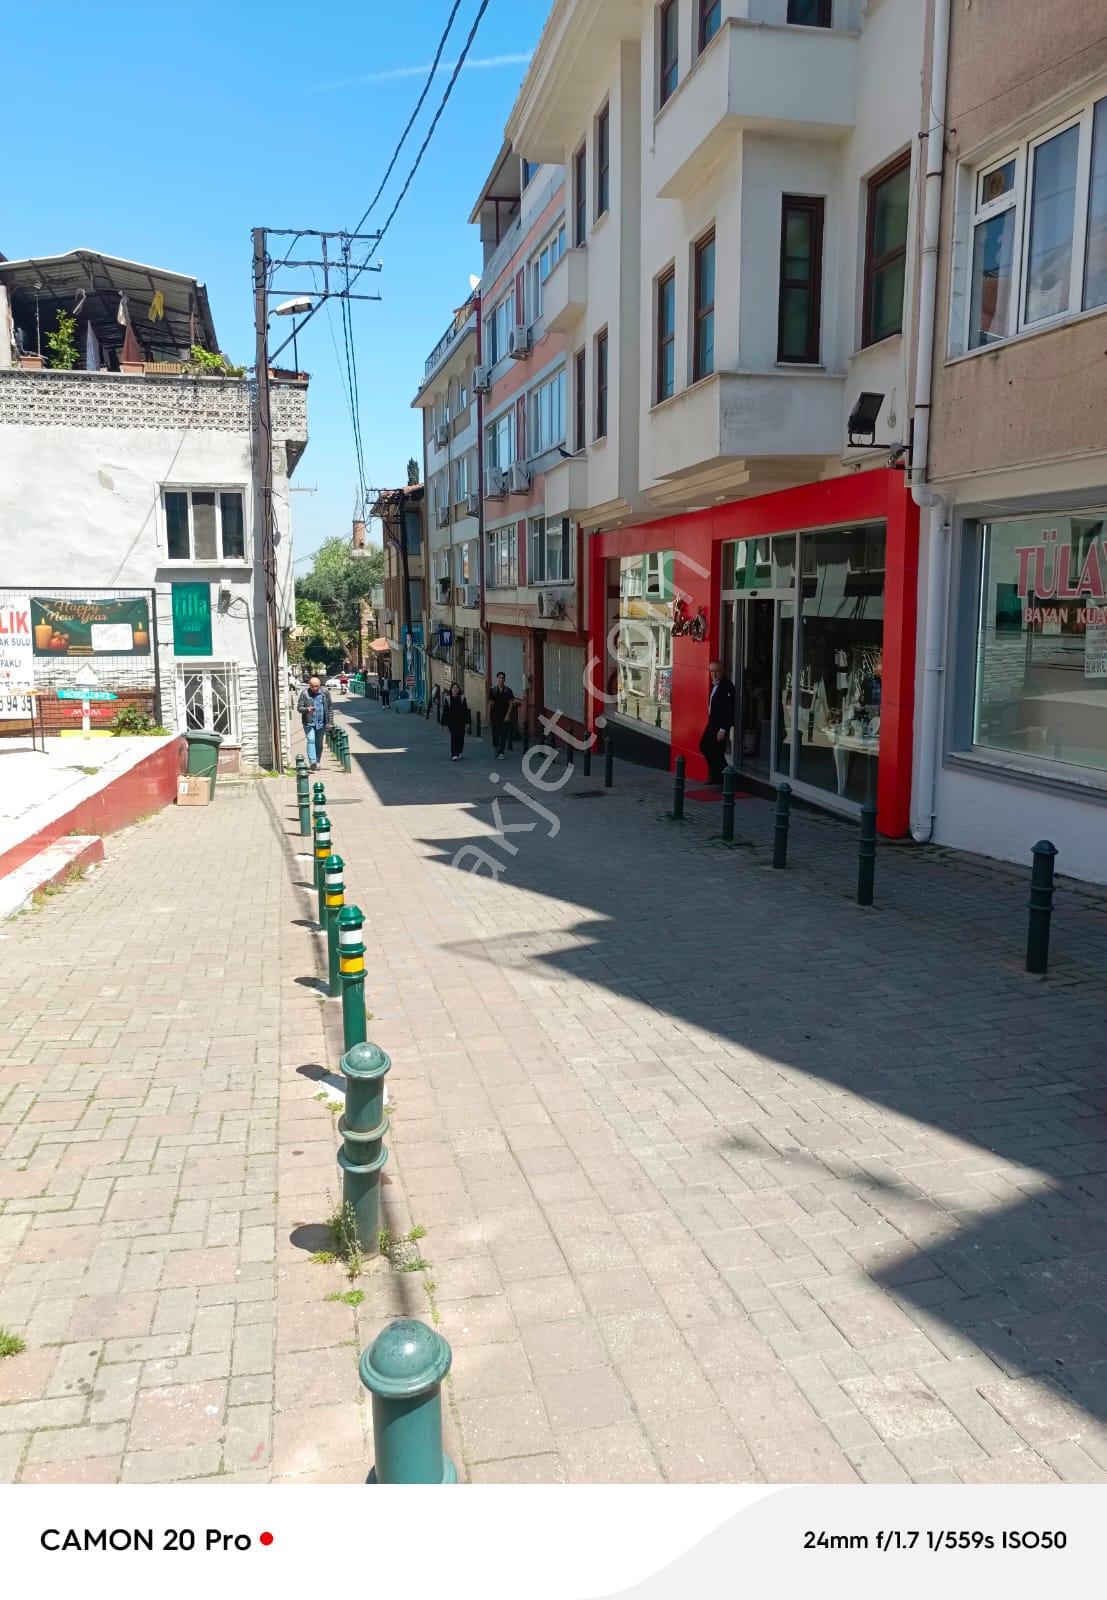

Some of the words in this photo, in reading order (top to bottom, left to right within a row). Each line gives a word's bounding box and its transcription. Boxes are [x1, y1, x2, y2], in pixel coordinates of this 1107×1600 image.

[55, 600, 100, 615] Happy
[47, 611, 74, 621] New
[79, 612, 108, 624] Year
[1024, 607, 1068, 624] BAYAN
[11, 637, 30, 646] SULU
